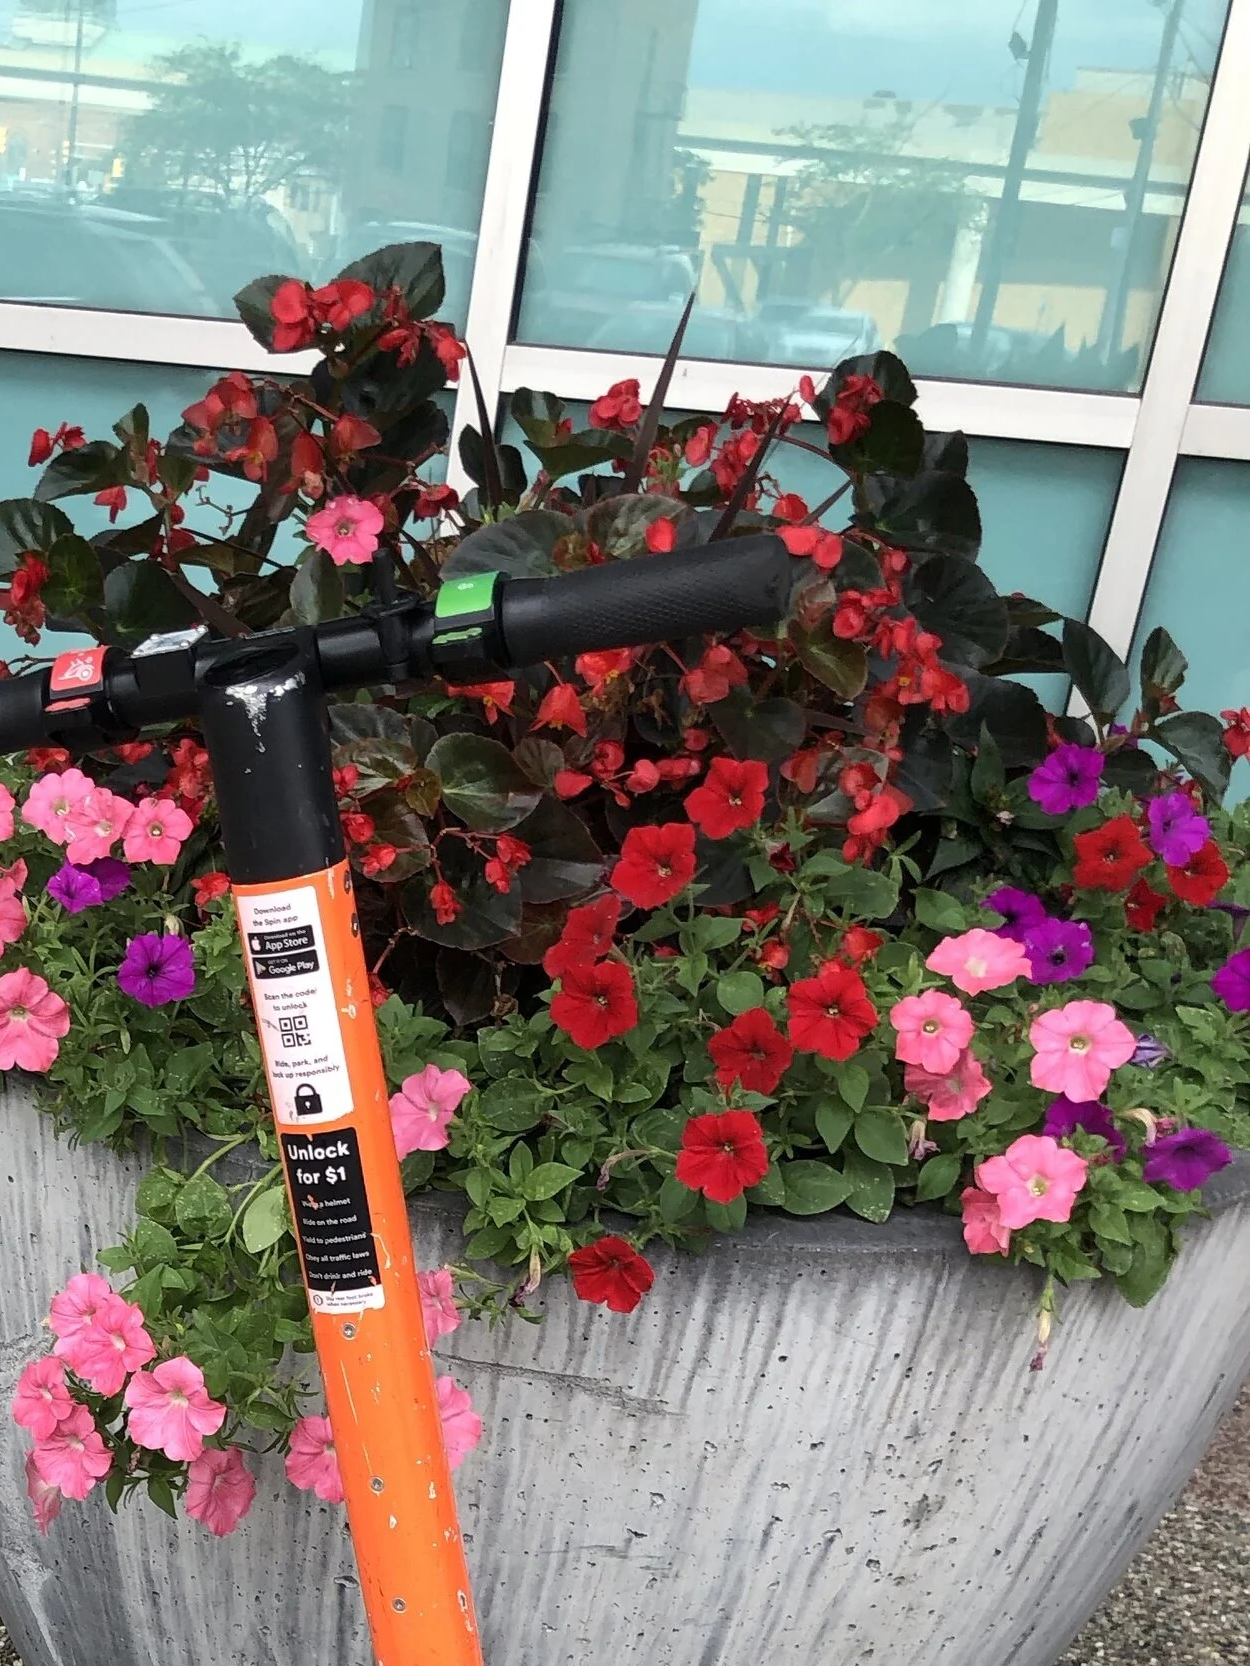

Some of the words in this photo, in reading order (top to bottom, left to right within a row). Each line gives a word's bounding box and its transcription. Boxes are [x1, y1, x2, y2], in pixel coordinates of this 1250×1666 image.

[253, 903, 291, 915] Download
[252, 919, 263, 927] the
[264, 917, 281, 926] Spin
[283, 915, 298, 923] app
[263, 932, 289, 940] Download
[265, 941, 283, 952] App
[283, 936, 309, 948] Store
[268, 963, 297, 975] Google
[296, 960, 315, 970] Play
[264, 993, 280, 1001] Scan
[281, 1001, 308, 1011] unlock
[313, 1055, 328, 1064] and
[295, 1064, 340, 1078] responsibly
[287, 1140, 351, 1161] Unlock
[295, 1167, 321, 1185] for
[325, 1165, 347, 1185] $1
[324, 1198, 351, 1208] helmet
[326, 1218, 339, 1226] the
[339, 1214, 357, 1224] road
[324, 1232, 367, 1245] pedestrians
[329, 1253, 352, 1262] traffic
[352, 1250, 370, 1259] laws
[323, 1272, 341, 1280] drink
[342, 1271, 356, 1279] and
[357, 1269, 372, 1277] ride
